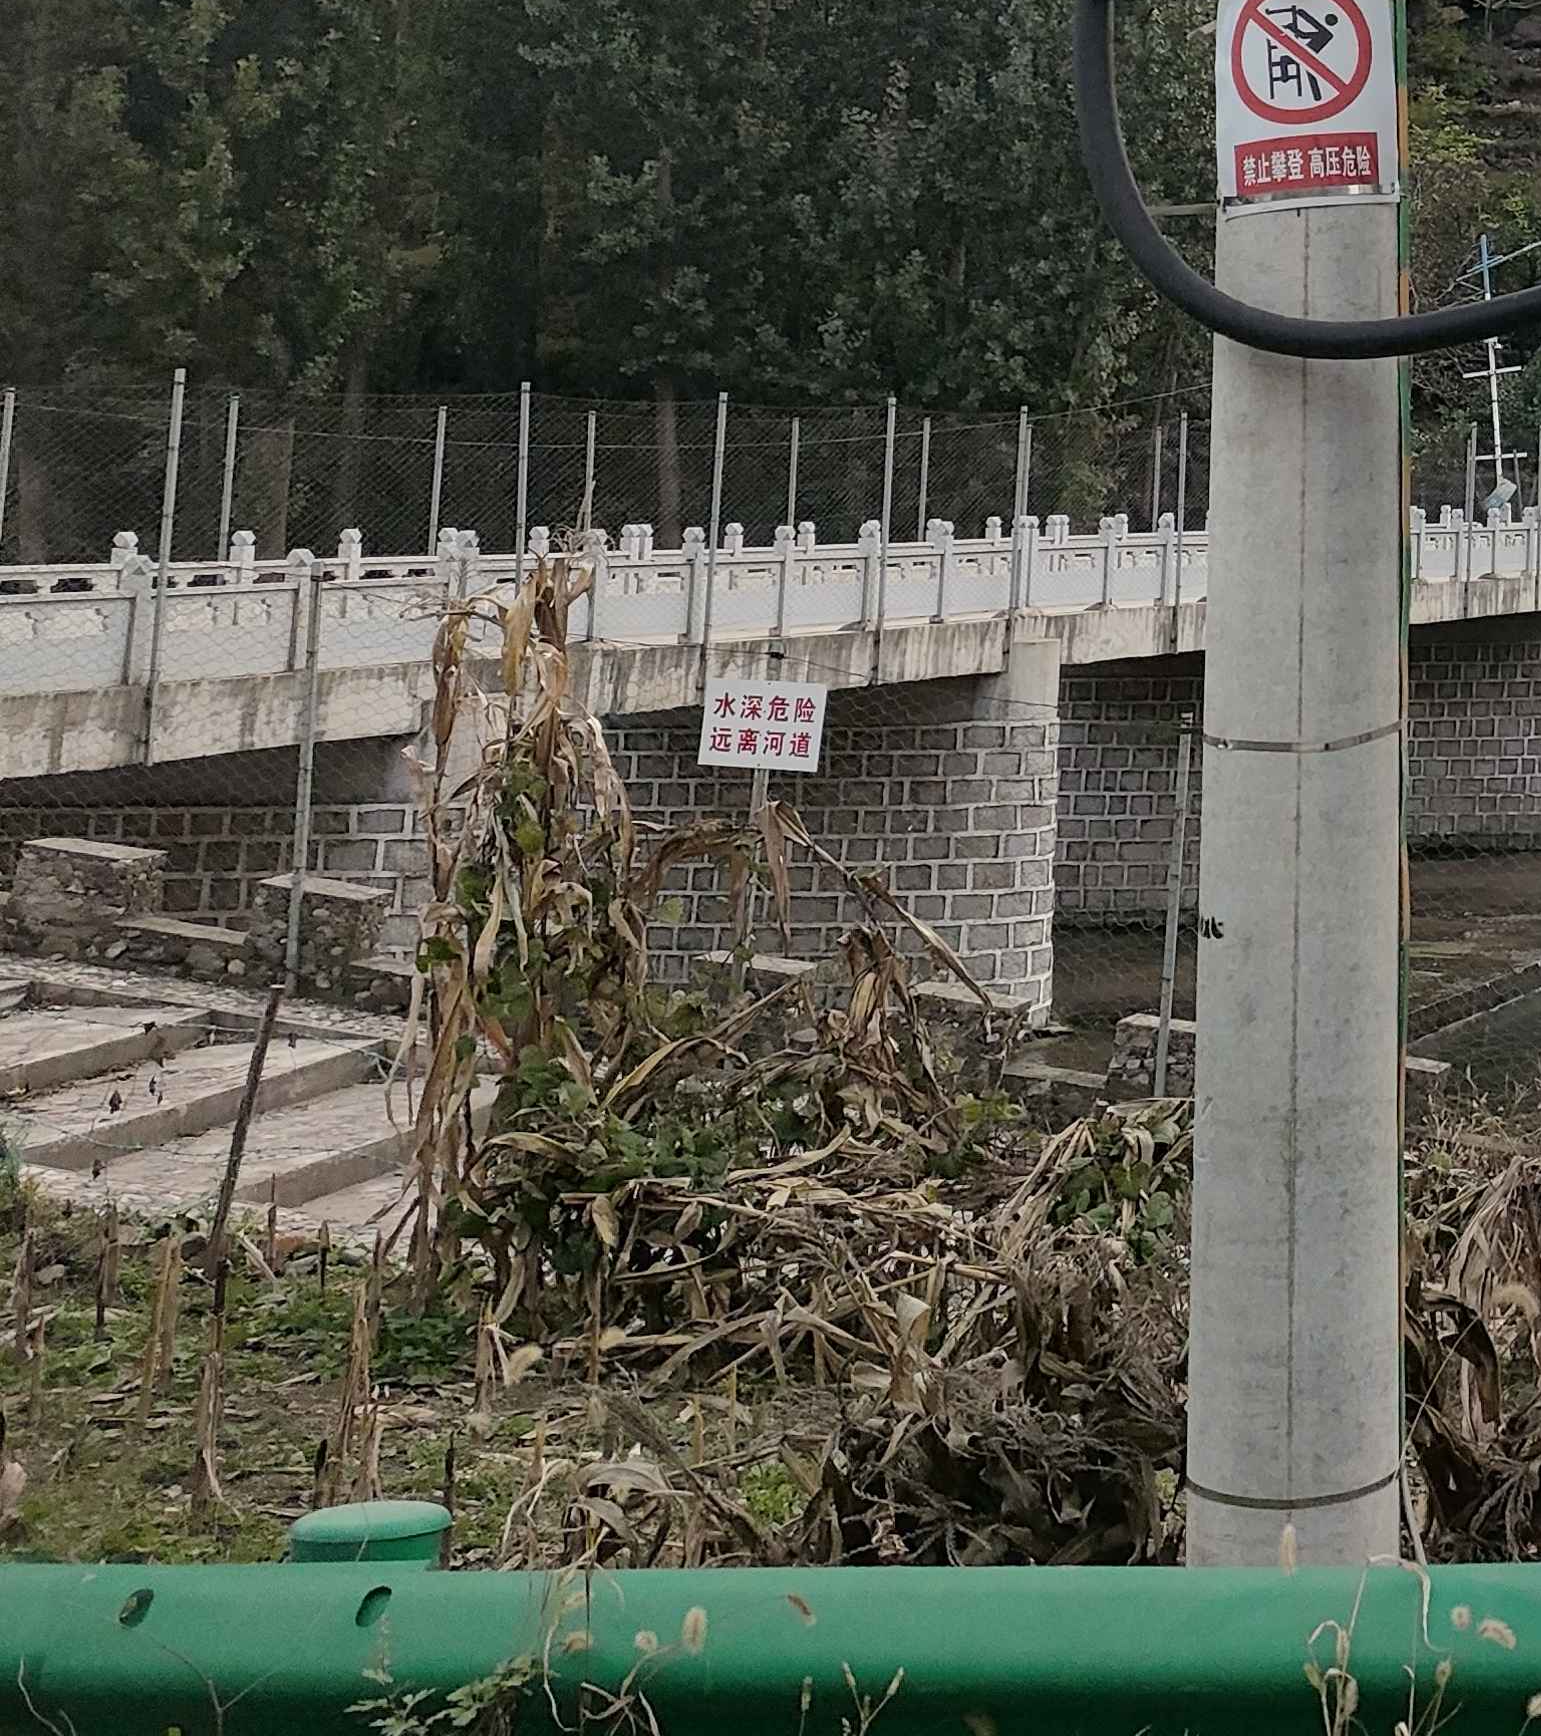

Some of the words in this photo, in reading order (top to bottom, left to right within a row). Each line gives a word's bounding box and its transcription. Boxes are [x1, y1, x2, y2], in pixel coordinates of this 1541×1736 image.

[1243, 148, 1305, 187] 禁止攀登
[1308, 145, 1372, 179] 高压危险
[713, 692, 816, 723] 水深危险
[709, 726, 812, 758] 远离河道
